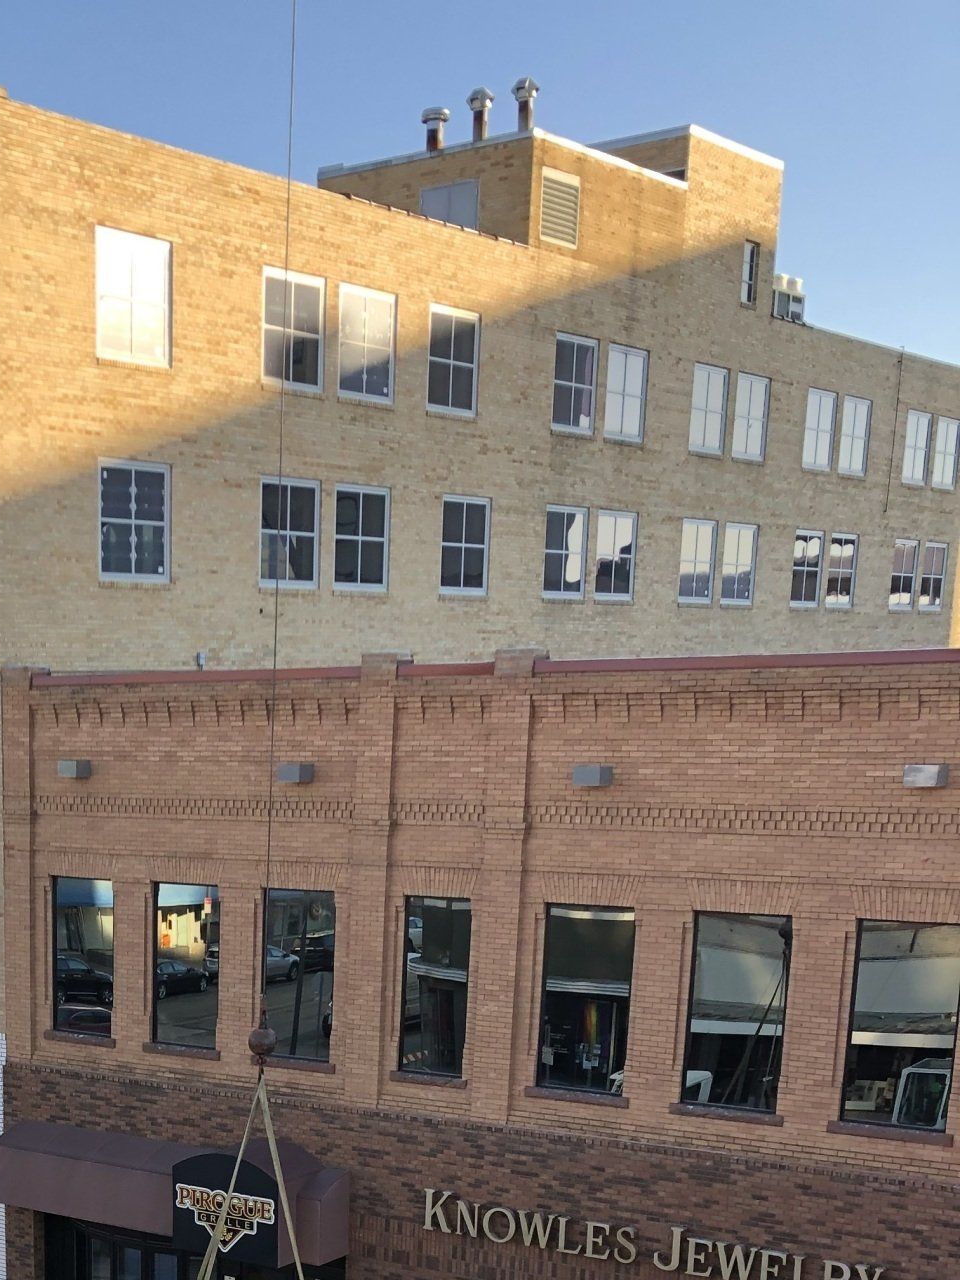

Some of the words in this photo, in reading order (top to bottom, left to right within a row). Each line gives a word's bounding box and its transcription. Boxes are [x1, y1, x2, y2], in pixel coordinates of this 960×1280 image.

[178, 1186, 273, 1221] PIROGUE
[200, 1213, 252, 1230] GRLLE
[422, 1187, 638, 1264] KNOWLES
